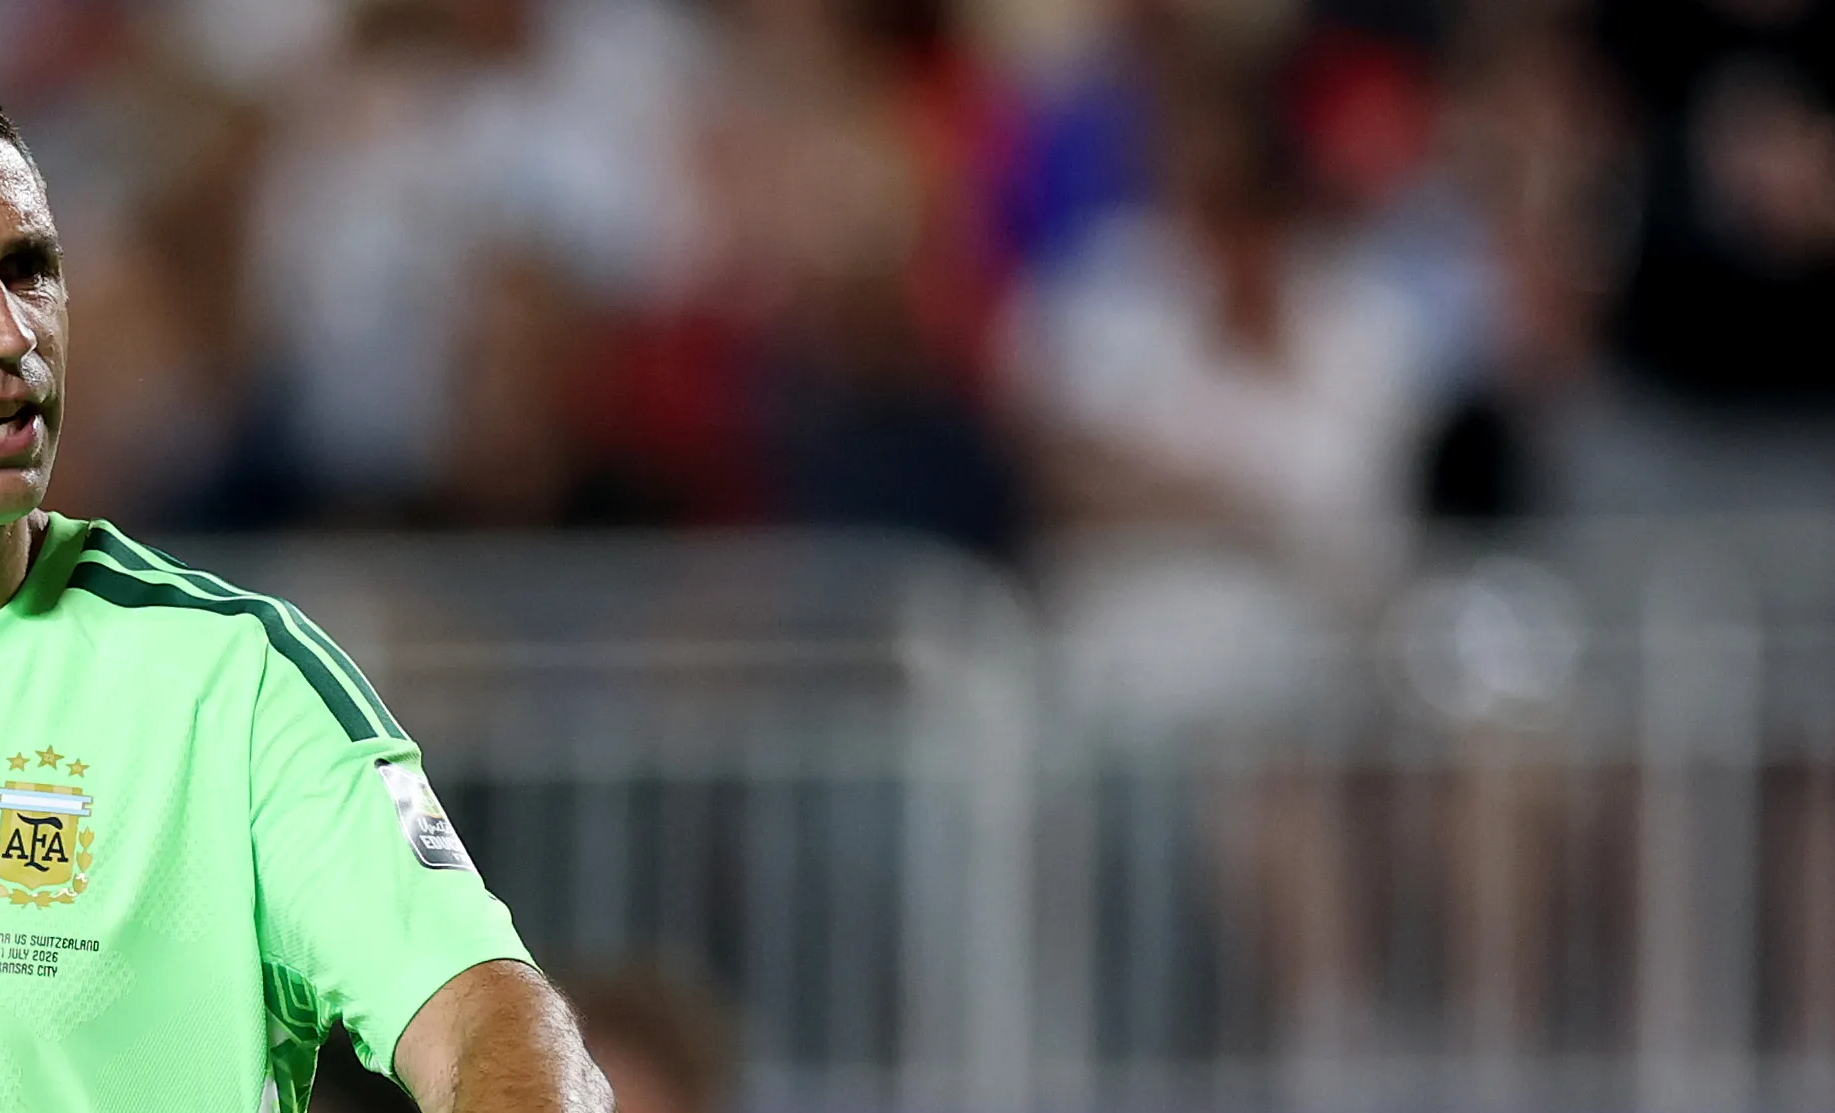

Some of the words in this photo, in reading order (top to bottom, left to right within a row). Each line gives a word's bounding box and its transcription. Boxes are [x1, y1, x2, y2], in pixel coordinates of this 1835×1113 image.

[1, 812, 69, 872] AFA
[14, 933, 27, 946] VS
[30, 935, 100, 952] SWITZERLAND
[8, 948, 29, 960] JULY
[32, 950, 59, 963] 2026
[37, 965, 58, 978] CITY
